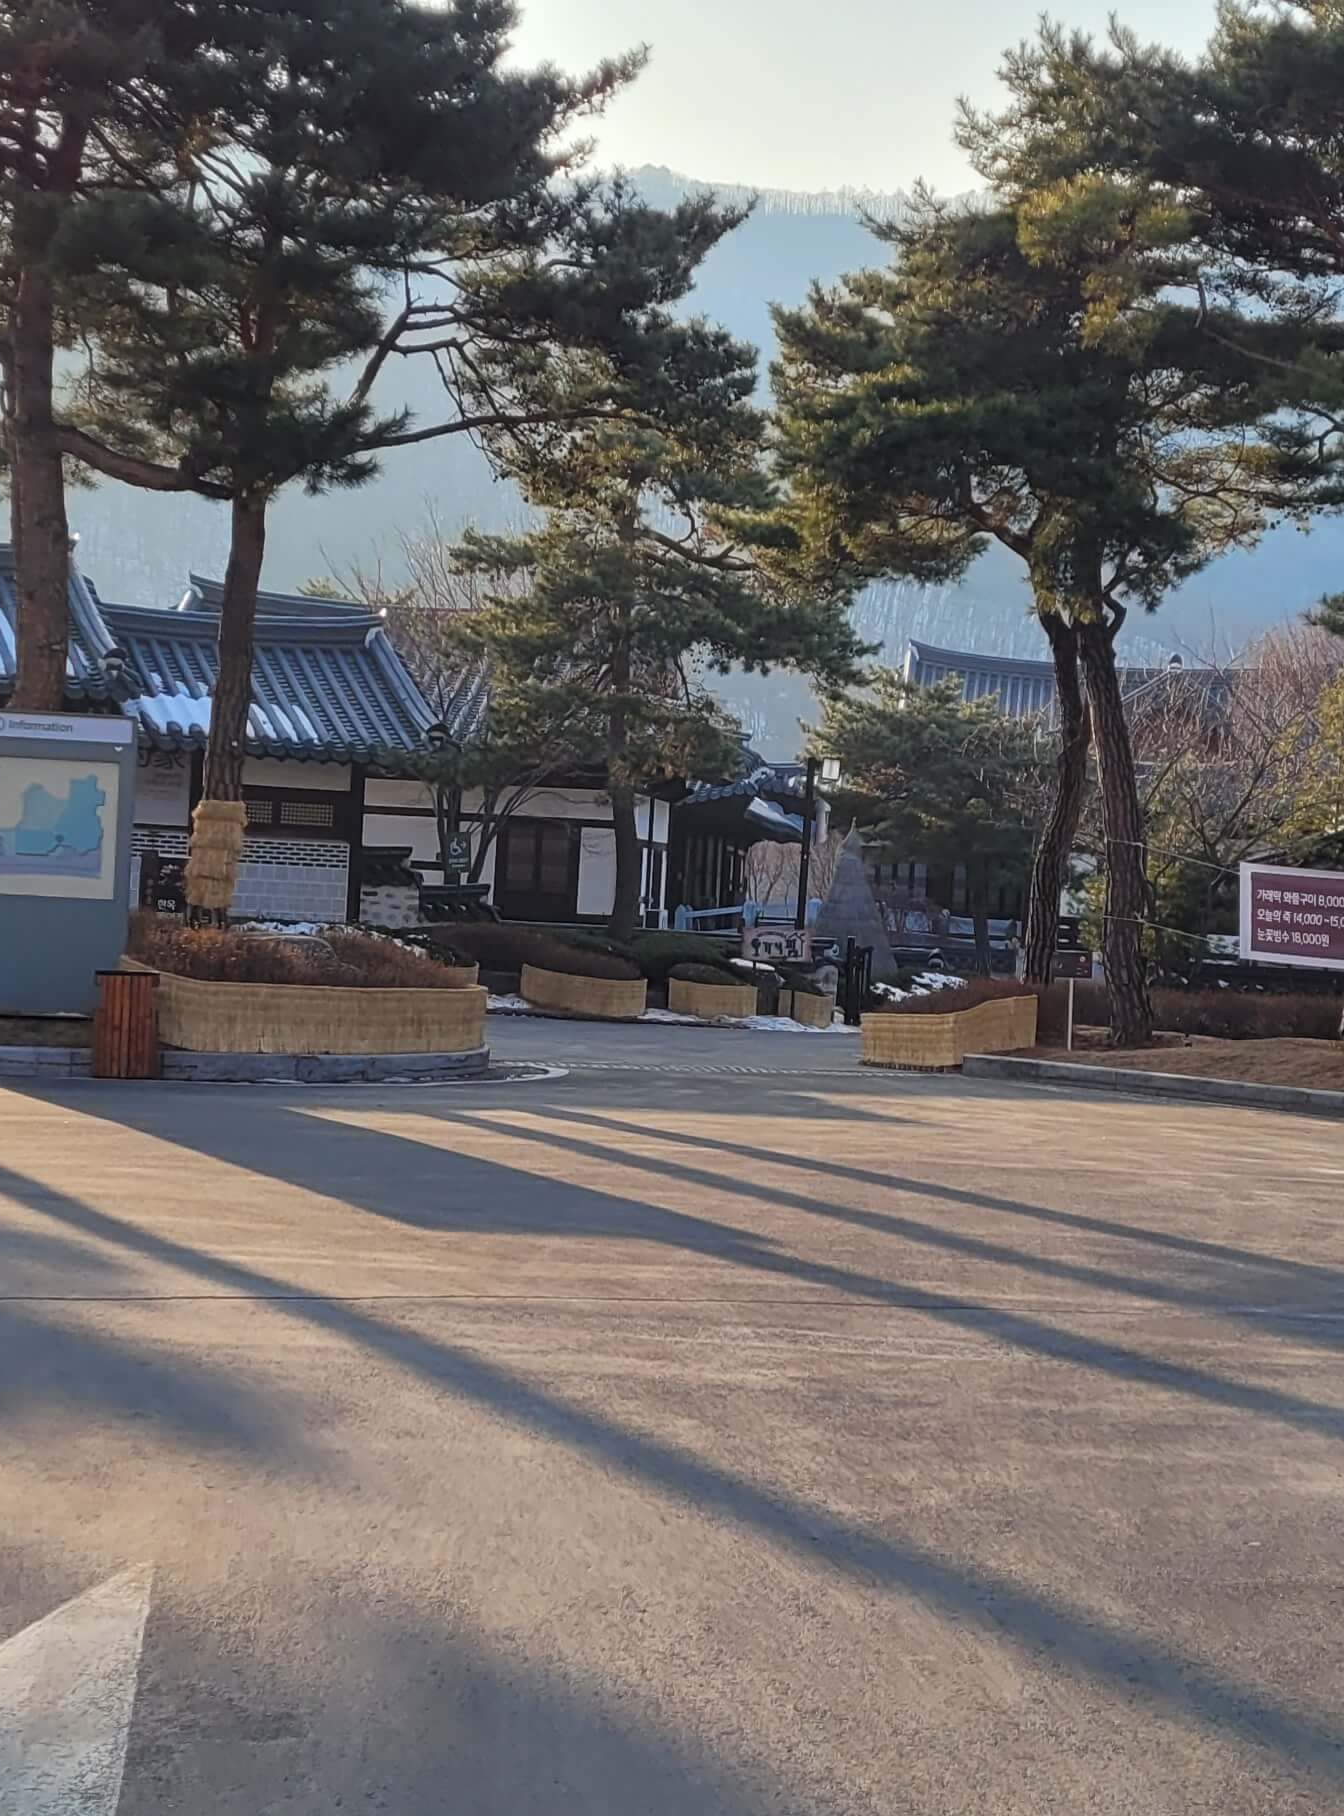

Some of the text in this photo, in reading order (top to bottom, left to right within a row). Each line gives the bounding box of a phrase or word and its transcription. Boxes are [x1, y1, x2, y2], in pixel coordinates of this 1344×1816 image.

[9, 719, 73, 732] Information
[1256, 908, 1282, 923] 오늘의
[1293, 912, 1323, 926] 14,000
[1291, 931, 1330, 947] 18,000원
